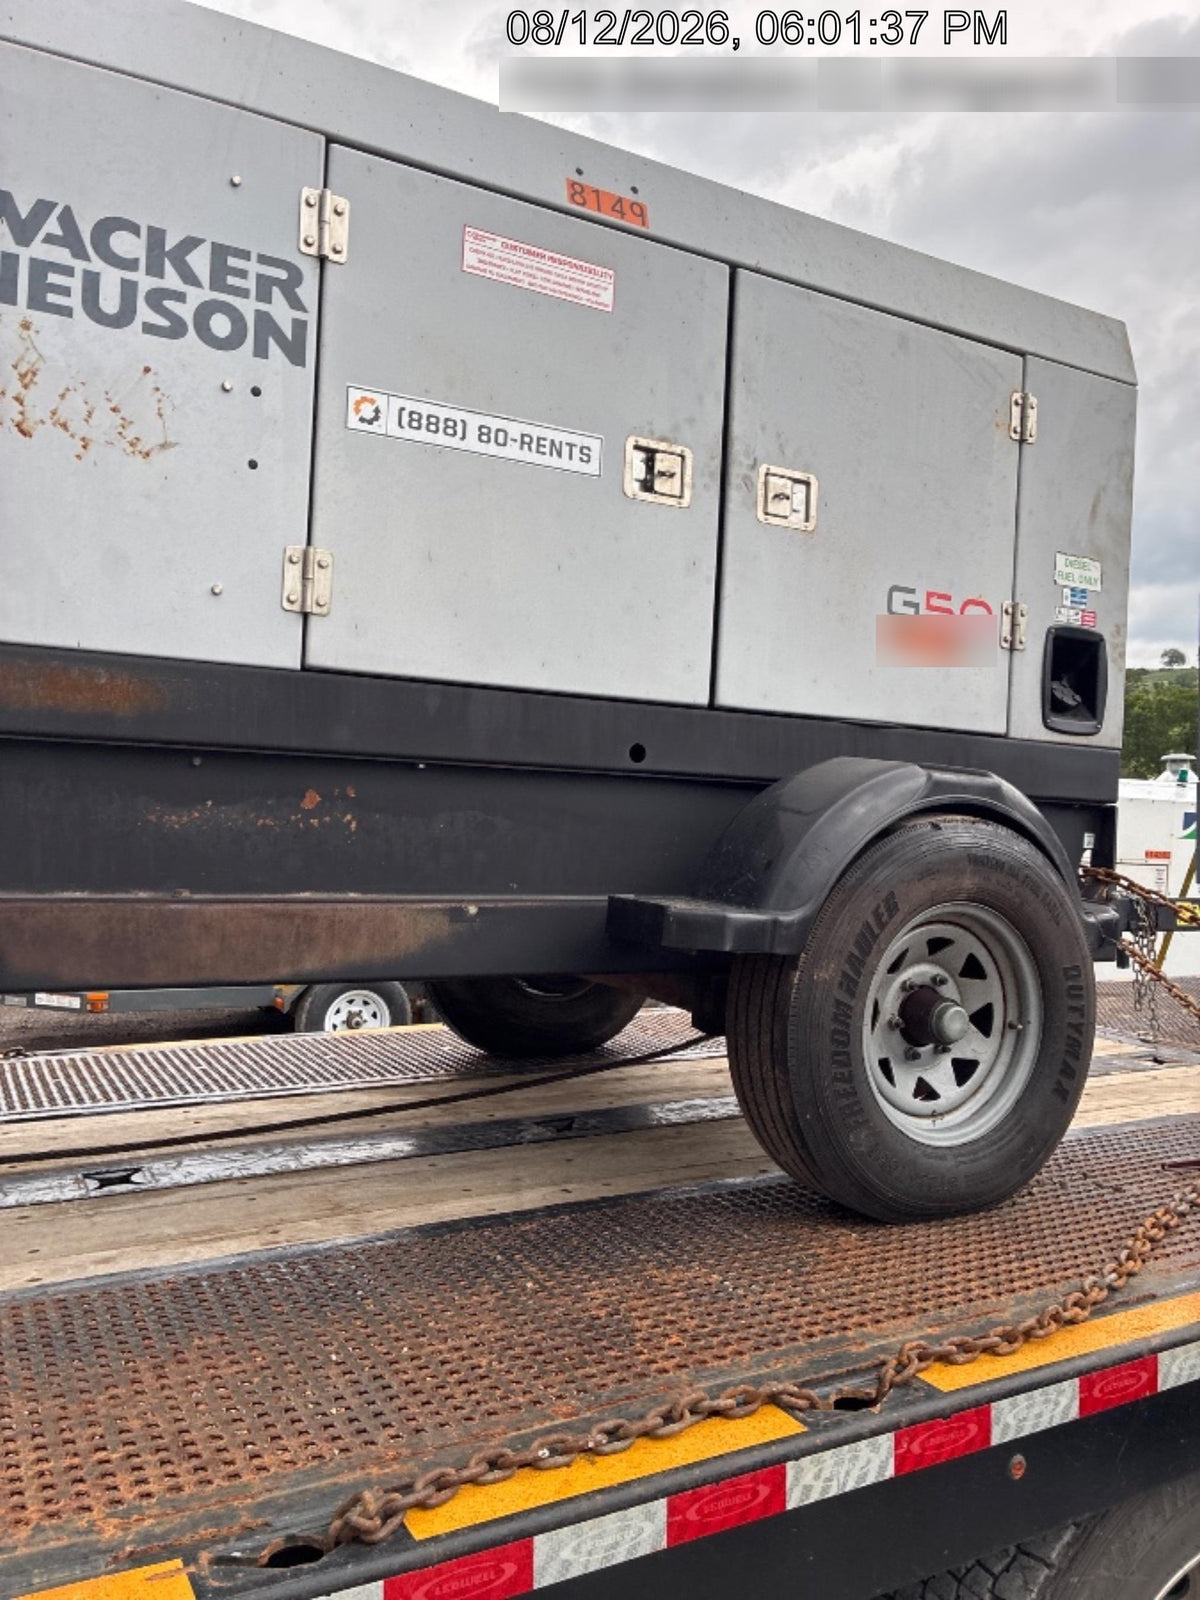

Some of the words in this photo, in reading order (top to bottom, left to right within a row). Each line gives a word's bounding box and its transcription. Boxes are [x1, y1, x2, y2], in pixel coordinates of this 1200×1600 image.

[571, 181, 646, 227] 8149
[398, 407, 467, 441] (888)
[477, 425, 593, 464] 80-RENTS
[1052, 965, 1085, 1104] DUTYMAX
